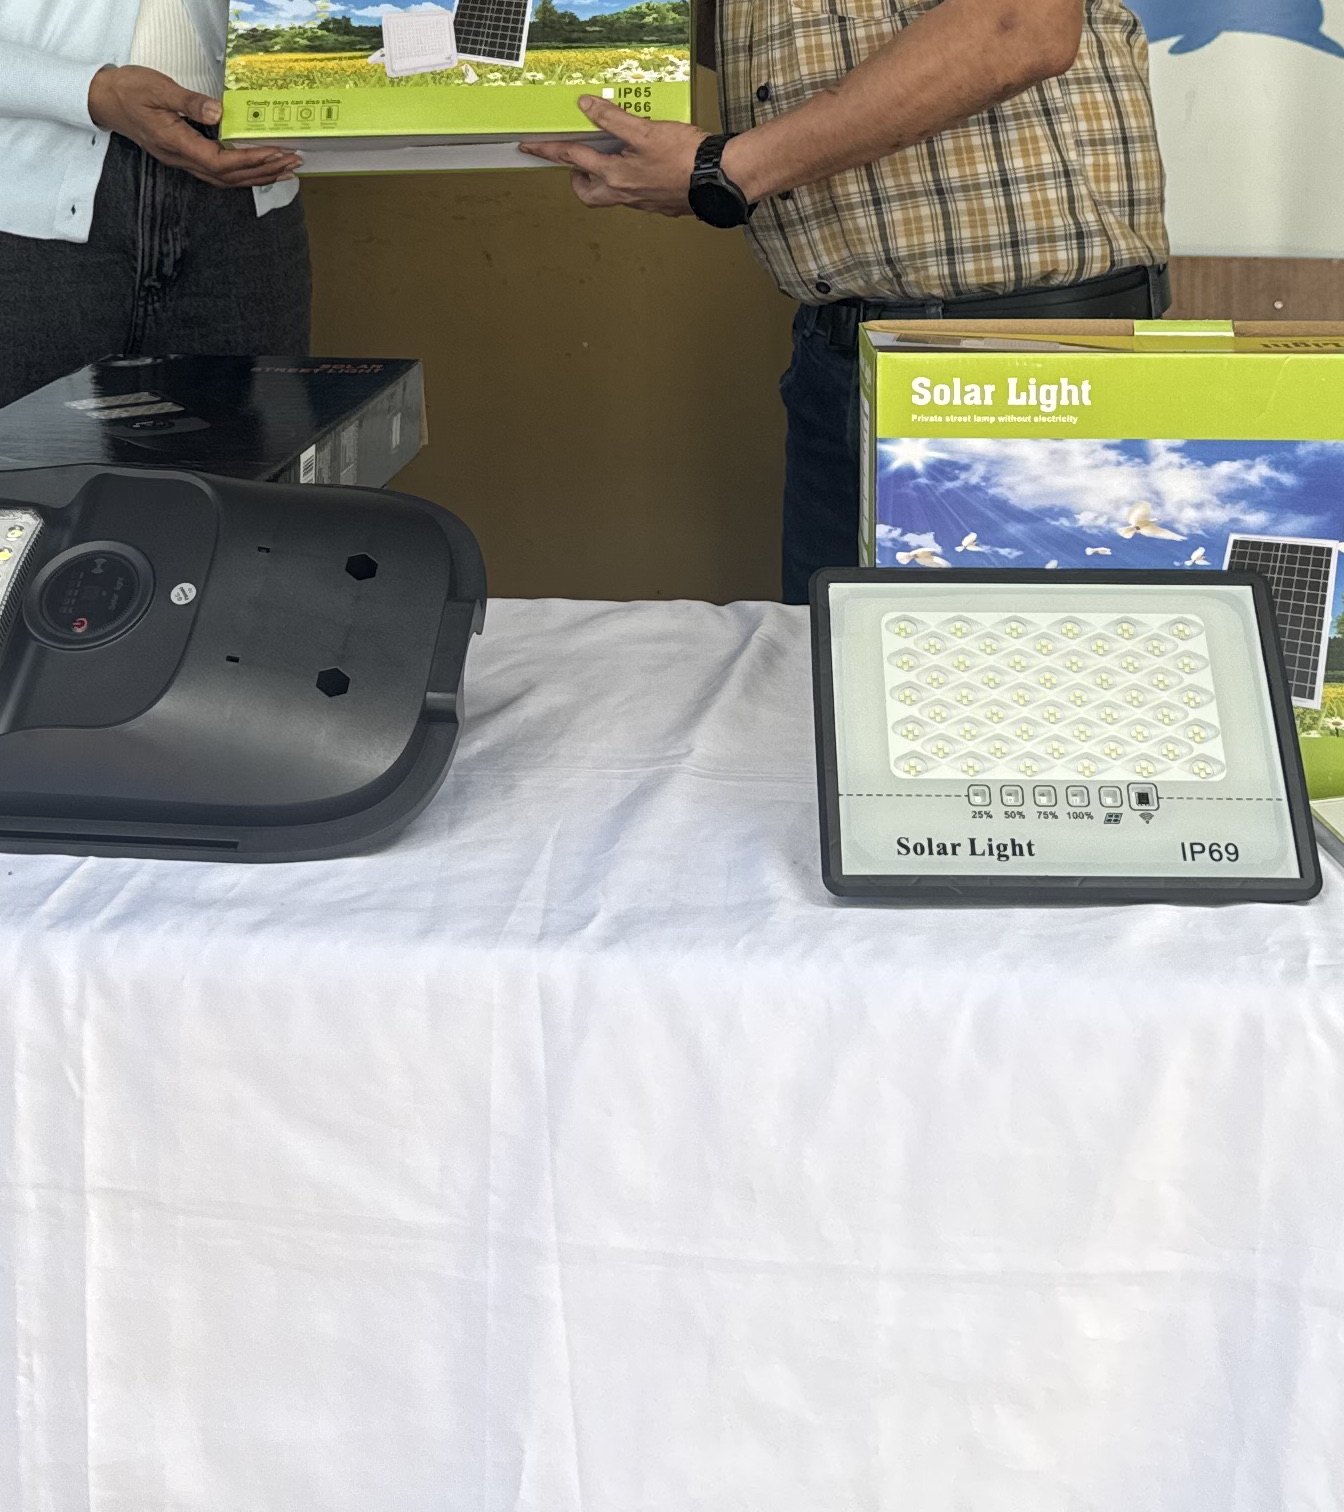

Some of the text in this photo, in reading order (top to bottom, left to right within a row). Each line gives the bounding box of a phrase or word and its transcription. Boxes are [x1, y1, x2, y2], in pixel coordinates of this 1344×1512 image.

[617, 86, 652, 99] IP65
[911, 376, 1092, 413] Solar Light
[911, 413, 1079, 425] Private street lamp without electricity
[971, 810, 1094, 821] 25% 50% 75% 100%
[896, 836, 1036, 862] Solar Light
[1181, 841, 1240, 862] IP69
